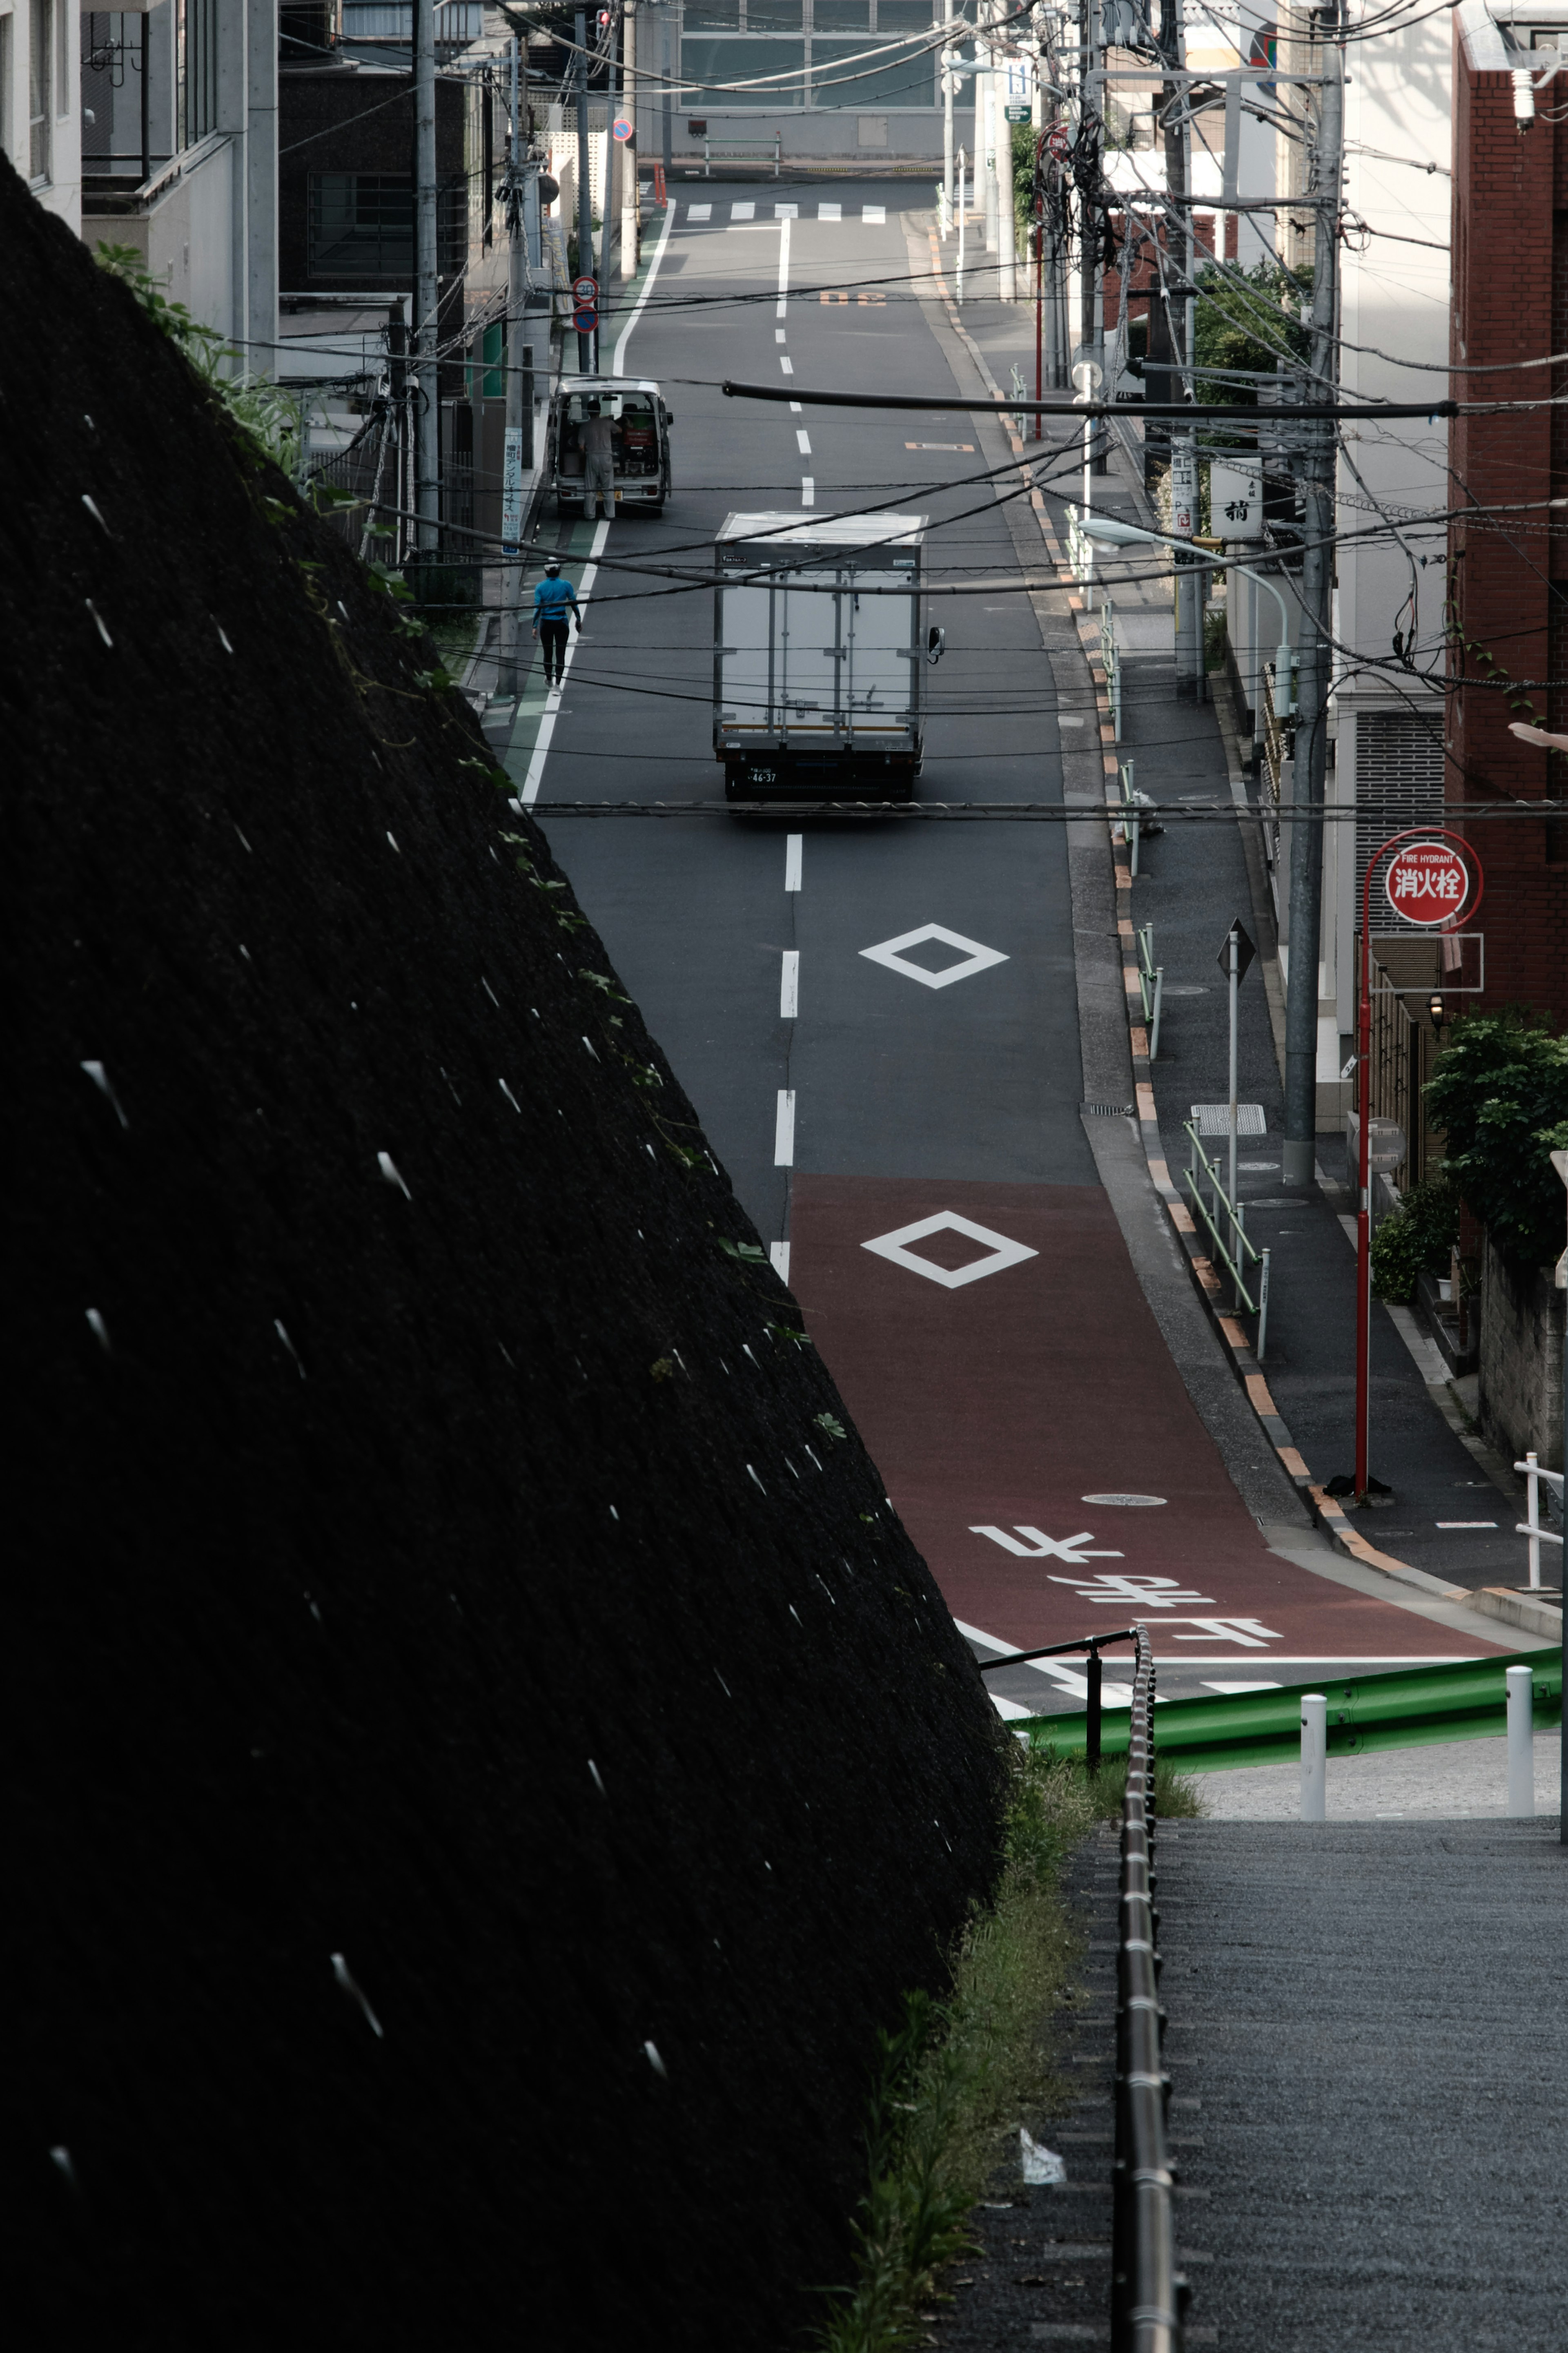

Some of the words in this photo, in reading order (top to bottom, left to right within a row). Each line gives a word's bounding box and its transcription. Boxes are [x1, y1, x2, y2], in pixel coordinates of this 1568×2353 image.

[578, 284, 593, 296] 30
[753, 774, 776, 782] 46-37
[1402, 854, 1418, 863] FIRE
[1420, 855, 1454, 863] HYDRANT
[1395, 868, 1461, 898] 消火栓
